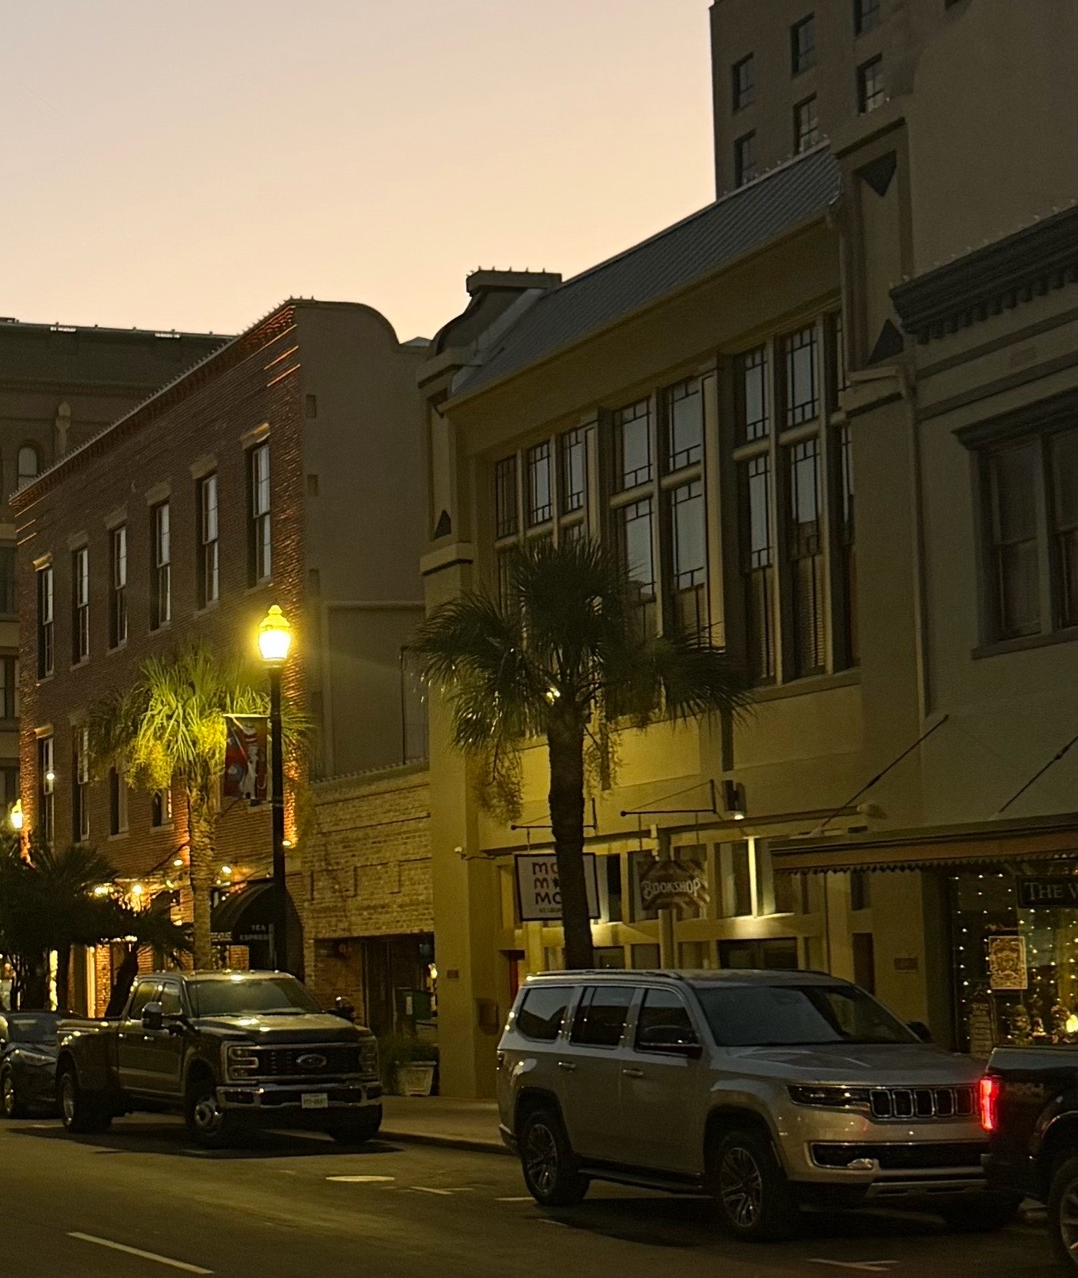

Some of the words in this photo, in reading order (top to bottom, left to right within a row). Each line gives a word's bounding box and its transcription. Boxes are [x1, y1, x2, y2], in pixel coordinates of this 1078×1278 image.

[531, 862, 560, 876] MO
[640, 877, 702, 901] BOOKSHOP
[1024, 881, 1064, 901] THE
[535, 891, 562, 905] MO
